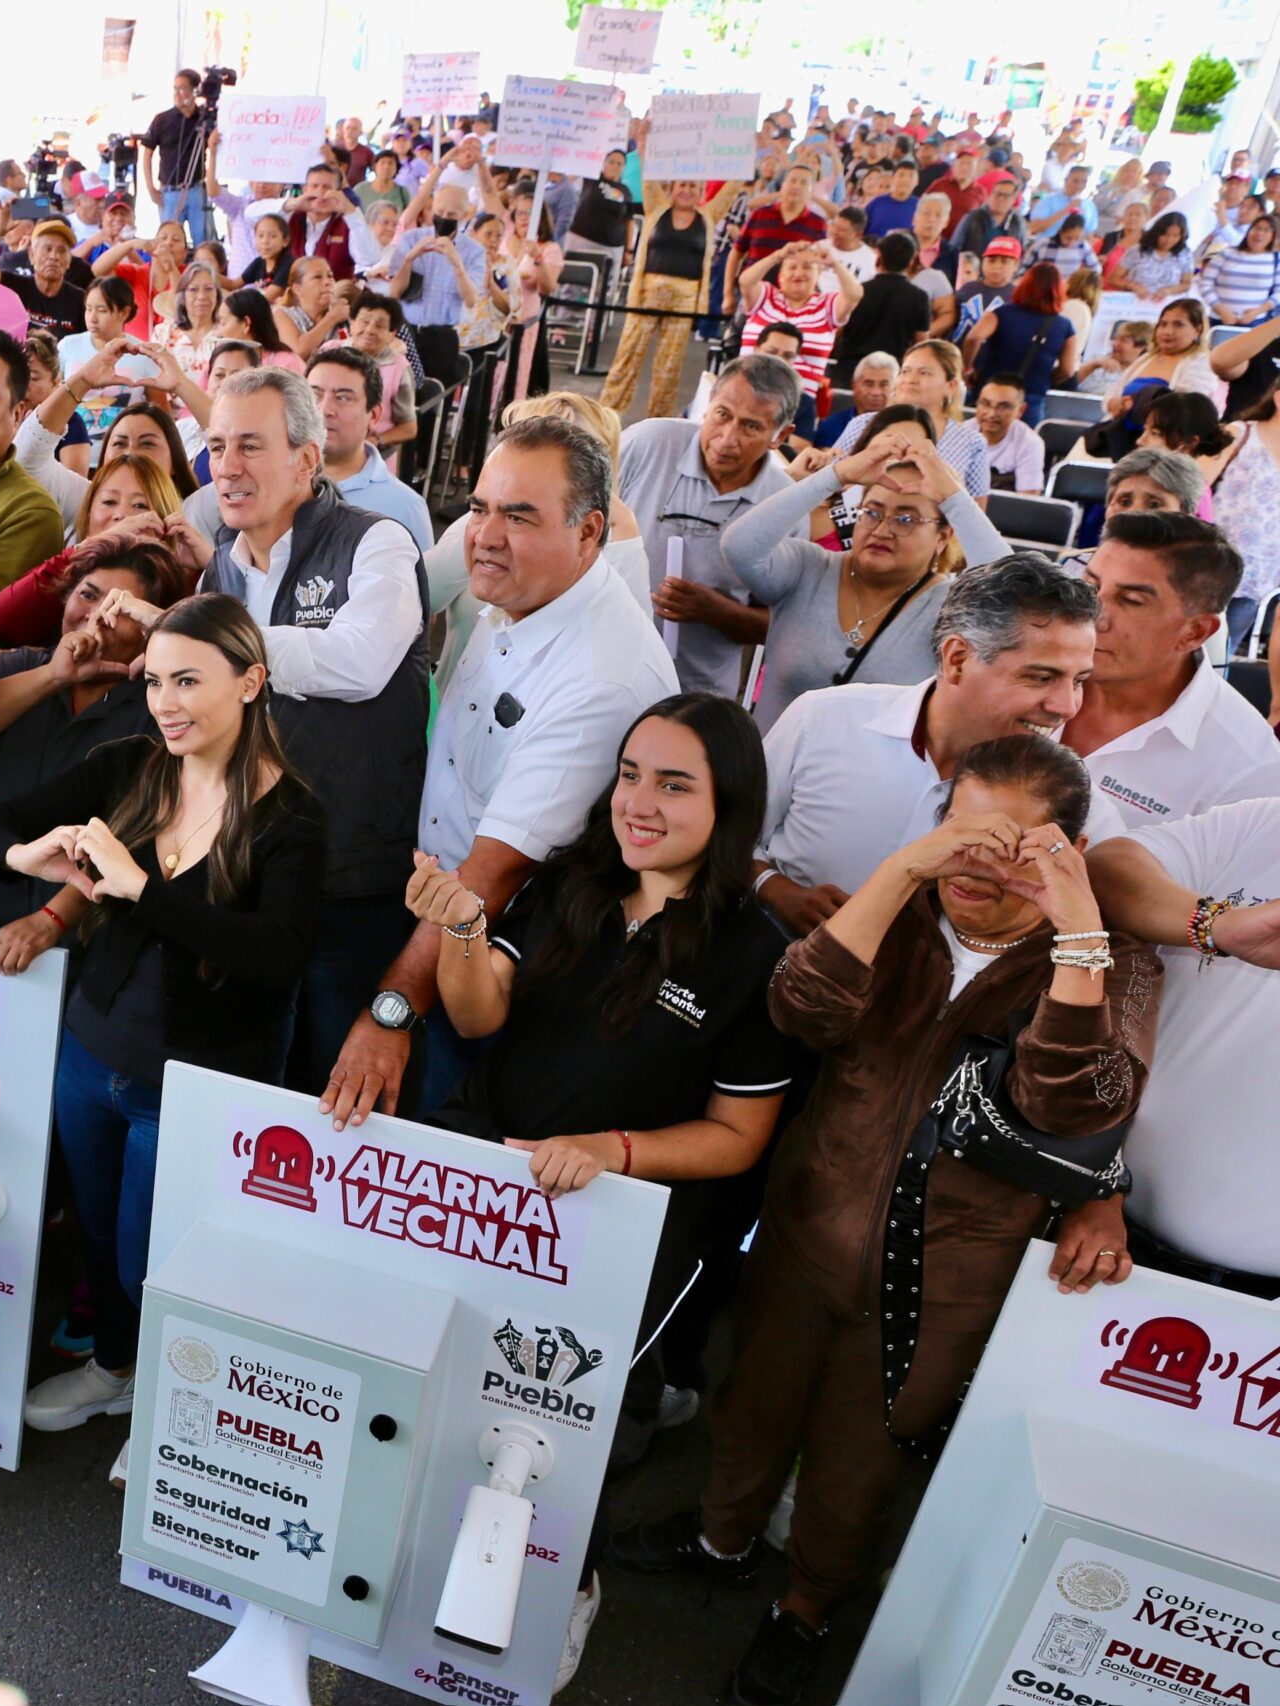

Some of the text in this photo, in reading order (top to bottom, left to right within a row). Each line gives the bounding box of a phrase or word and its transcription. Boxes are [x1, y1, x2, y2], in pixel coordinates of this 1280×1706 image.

[1100, 775, 1171, 815] Bienestar
[338, 1144, 561, 1240] ALARMA
[341, 1180, 568, 1286] VECINAL
[226, 1367, 340, 1423] México
[229, 1354, 343, 1401] Gobierno de
[482, 1370, 596, 1423] Puebla
[216, 1409, 324, 1461] PUEBLA
[481, 1394, 592, 1432] GOBIERNO DE LA CIUDAD
[215, 1428, 323, 1471] Gobierno del Estado
[158, 1444, 308, 1508] Gobernación
[195, 1472, 206, 1481] de
[206, 1476, 255, 1498] Gobernación
[155, 1478, 271, 1532] Seguridad
[190, 1508, 200, 1517] de
[201, 1512, 239, 1532] Seguridad
[152, 1510, 260, 1562] Bienestar
[188, 1538, 199, 1547] de
[199, 1542, 234, 1561] Bienestar
[524, 1542, 561, 1563] paz
[148, 1567, 233, 1611] PUEBLA
[1146, 1586, 1265, 1634] Gobierno
[1132, 1598, 1280, 1668] México
[414, 1667, 442, 1686] en
[437, 1660, 520, 1701] Pensar
[1100, 1658, 1167, 1687] Gobierno
[1168, 1682, 1194, 1696] del
[1104, 1639, 1252, 1705] PUEBLA
